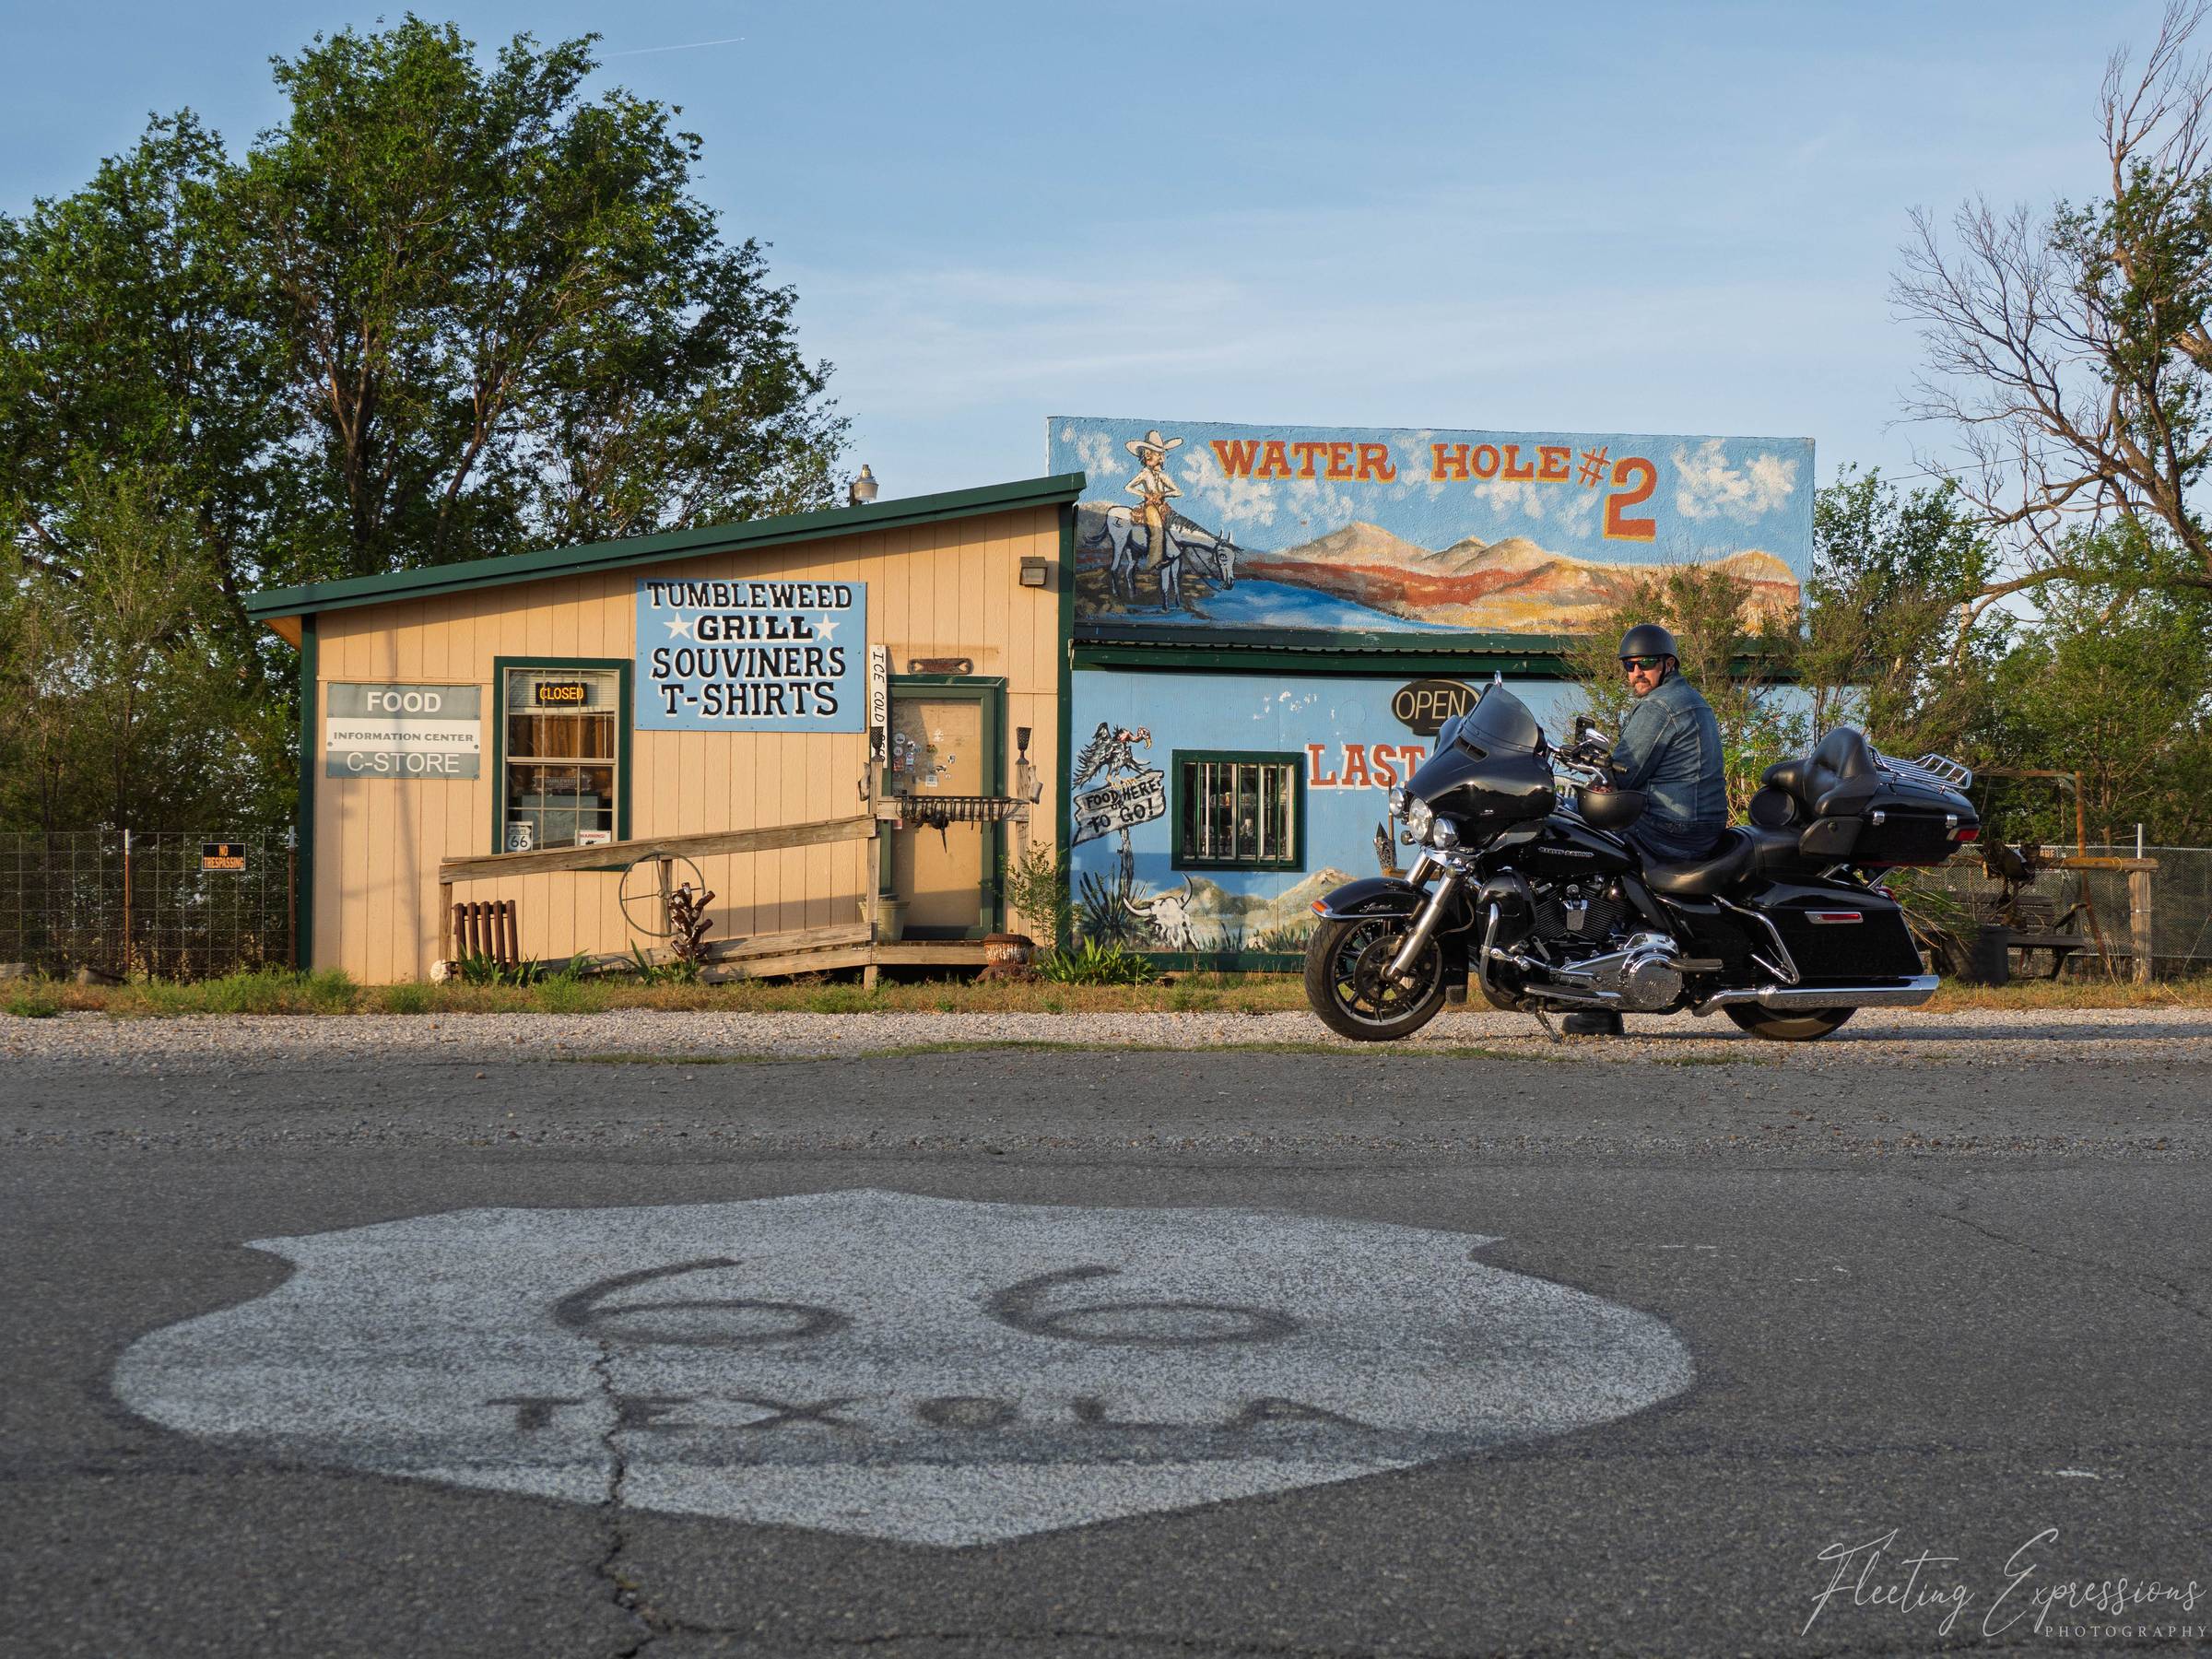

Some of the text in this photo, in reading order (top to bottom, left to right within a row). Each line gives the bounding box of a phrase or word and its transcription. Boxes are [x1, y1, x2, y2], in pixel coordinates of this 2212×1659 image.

[1209, 440, 1396, 483] WATER
[1430, 442, 1571, 482] HOLE
[647, 582, 853, 610] TUMBLEWEED
[693, 615, 813, 643] GRILL
[649, 646, 846, 680] SOUVINERS
[872, 651, 885, 683] ICE
[367, 691, 442, 712] FOOD
[539, 687, 584, 700] CLOSED
[658, 682, 839, 718] T-SHIRTS
[874, 691, 885, 723] COLD
[1395, 690, 1465, 720] OPEN
[334, 732, 474, 742] INFORMATION CENTER
[347, 751, 461, 773] C-STORE
[1305, 743, 1426, 790] LAST
[1086, 778, 1161, 809] FOOD HERE
[1087, 797, 1153, 833] TO GO!
[218, 844, 229, 856] NO
[511, 835, 528, 848] 66
[203, 856, 244, 868] TRESPASSING
